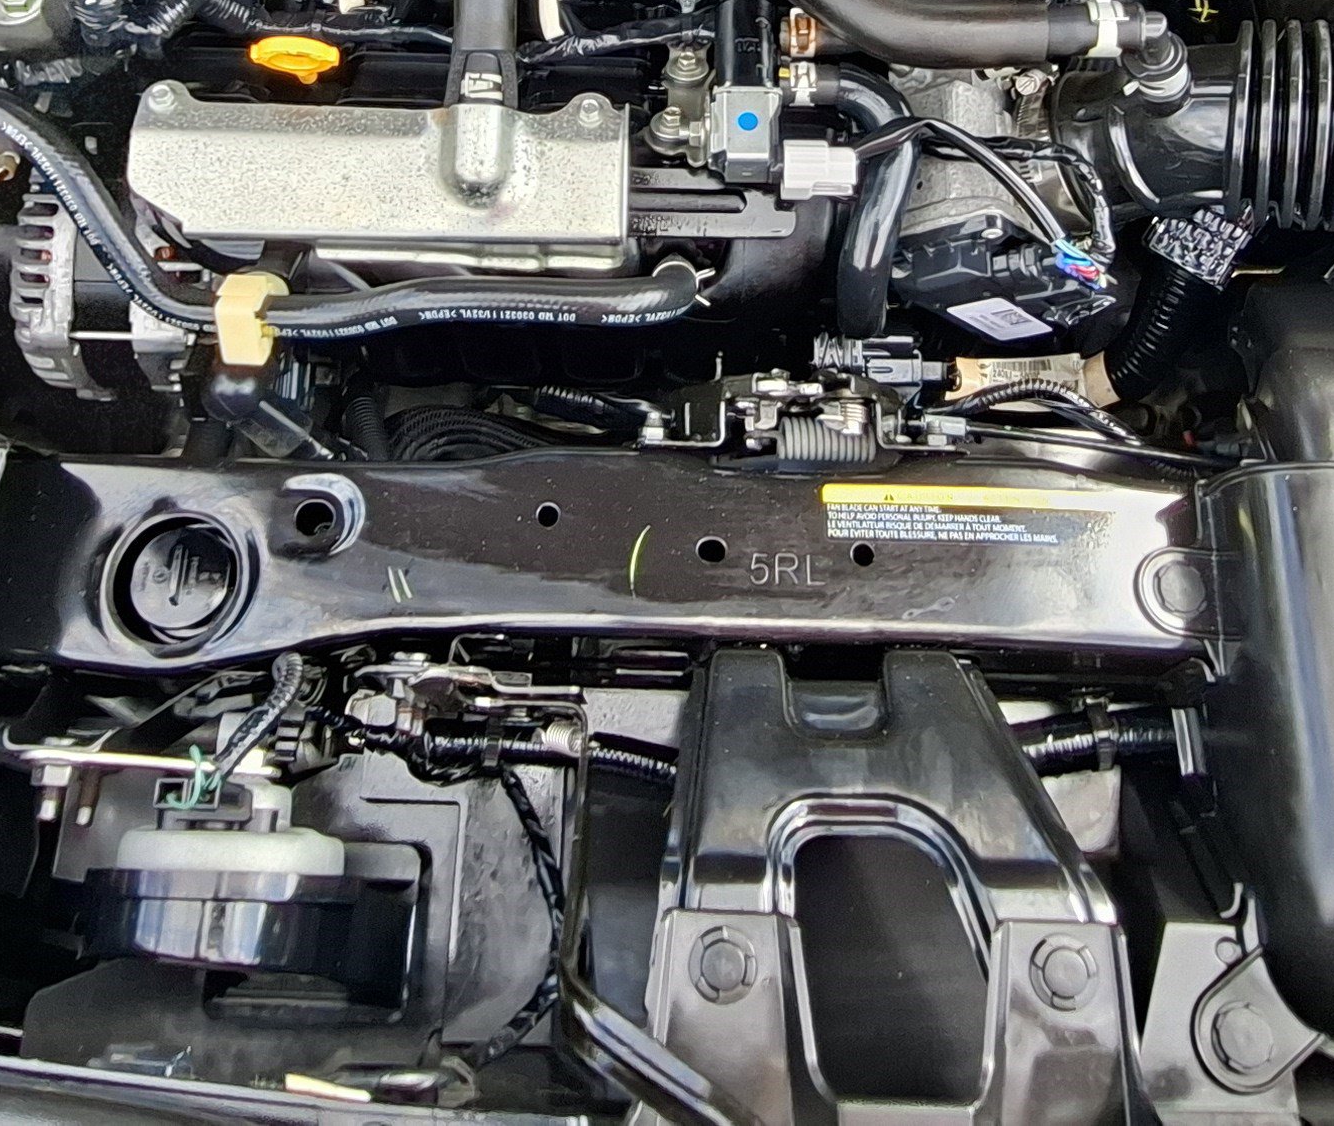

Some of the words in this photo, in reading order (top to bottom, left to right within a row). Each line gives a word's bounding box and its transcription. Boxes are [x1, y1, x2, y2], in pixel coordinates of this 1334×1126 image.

[827, 504, 841, 512] FAN
[841, 504, 863, 512] BLADE
[863, 504, 878, 512] CAN
[879, 504, 899, 513] START
[899, 505, 909, 513] AT
[909, 505, 923, 513] ANY
[828, 511, 838, 520] TO
[838, 512, 856, 520] HELP
[856, 512, 877, 521] AVOID
[878, 513, 912, 521] PERSONAL
[937, 514, 954, 522] KEEP
[954, 514, 978, 522] HANDS
[828, 520, 836, 528] LE
[837, 520, 884, 529] VENTILATEUR
[886, 521, 912, 530] RISQUE
[913, 522, 923, 530] DE
[972, 523, 992, 531] TOUT
[828, 529, 849, 537] POUR
[875, 530, 899, 539] TOUTE
[938, 532, 950, 540] NE
[949, 532, 964, 540] PAS
[964, 532, 975, 540] EN
[975, 532, 1019, 541] APPROCHER
[1019, 533, 1032, 542] LES
[750, 552, 827, 586] 5RL
